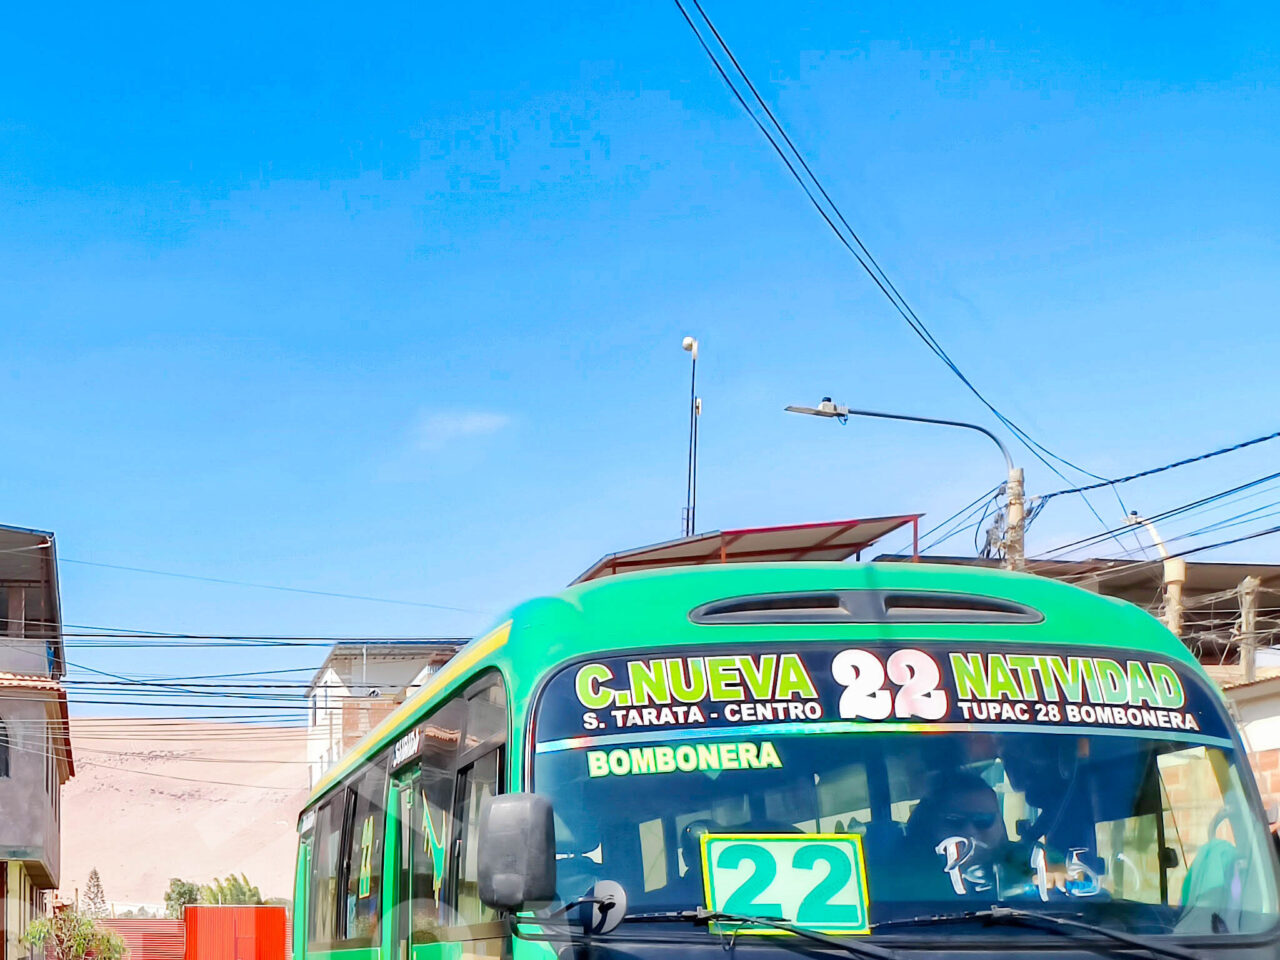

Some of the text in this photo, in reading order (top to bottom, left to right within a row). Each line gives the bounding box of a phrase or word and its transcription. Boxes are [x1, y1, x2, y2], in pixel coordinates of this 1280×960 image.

[575, 648, 1185, 721] C.NUEVA 22 NATIVIDAD
[582, 711, 606, 730] S.
[611, 704, 705, 728] TARATA
[723, 701, 822, 722] CENTRO
[957, 703, 1200, 731] TUPAC 28 BOMBONERA
[587, 742, 782, 777] BOMBONERA
[715, 843, 860, 923] 22
